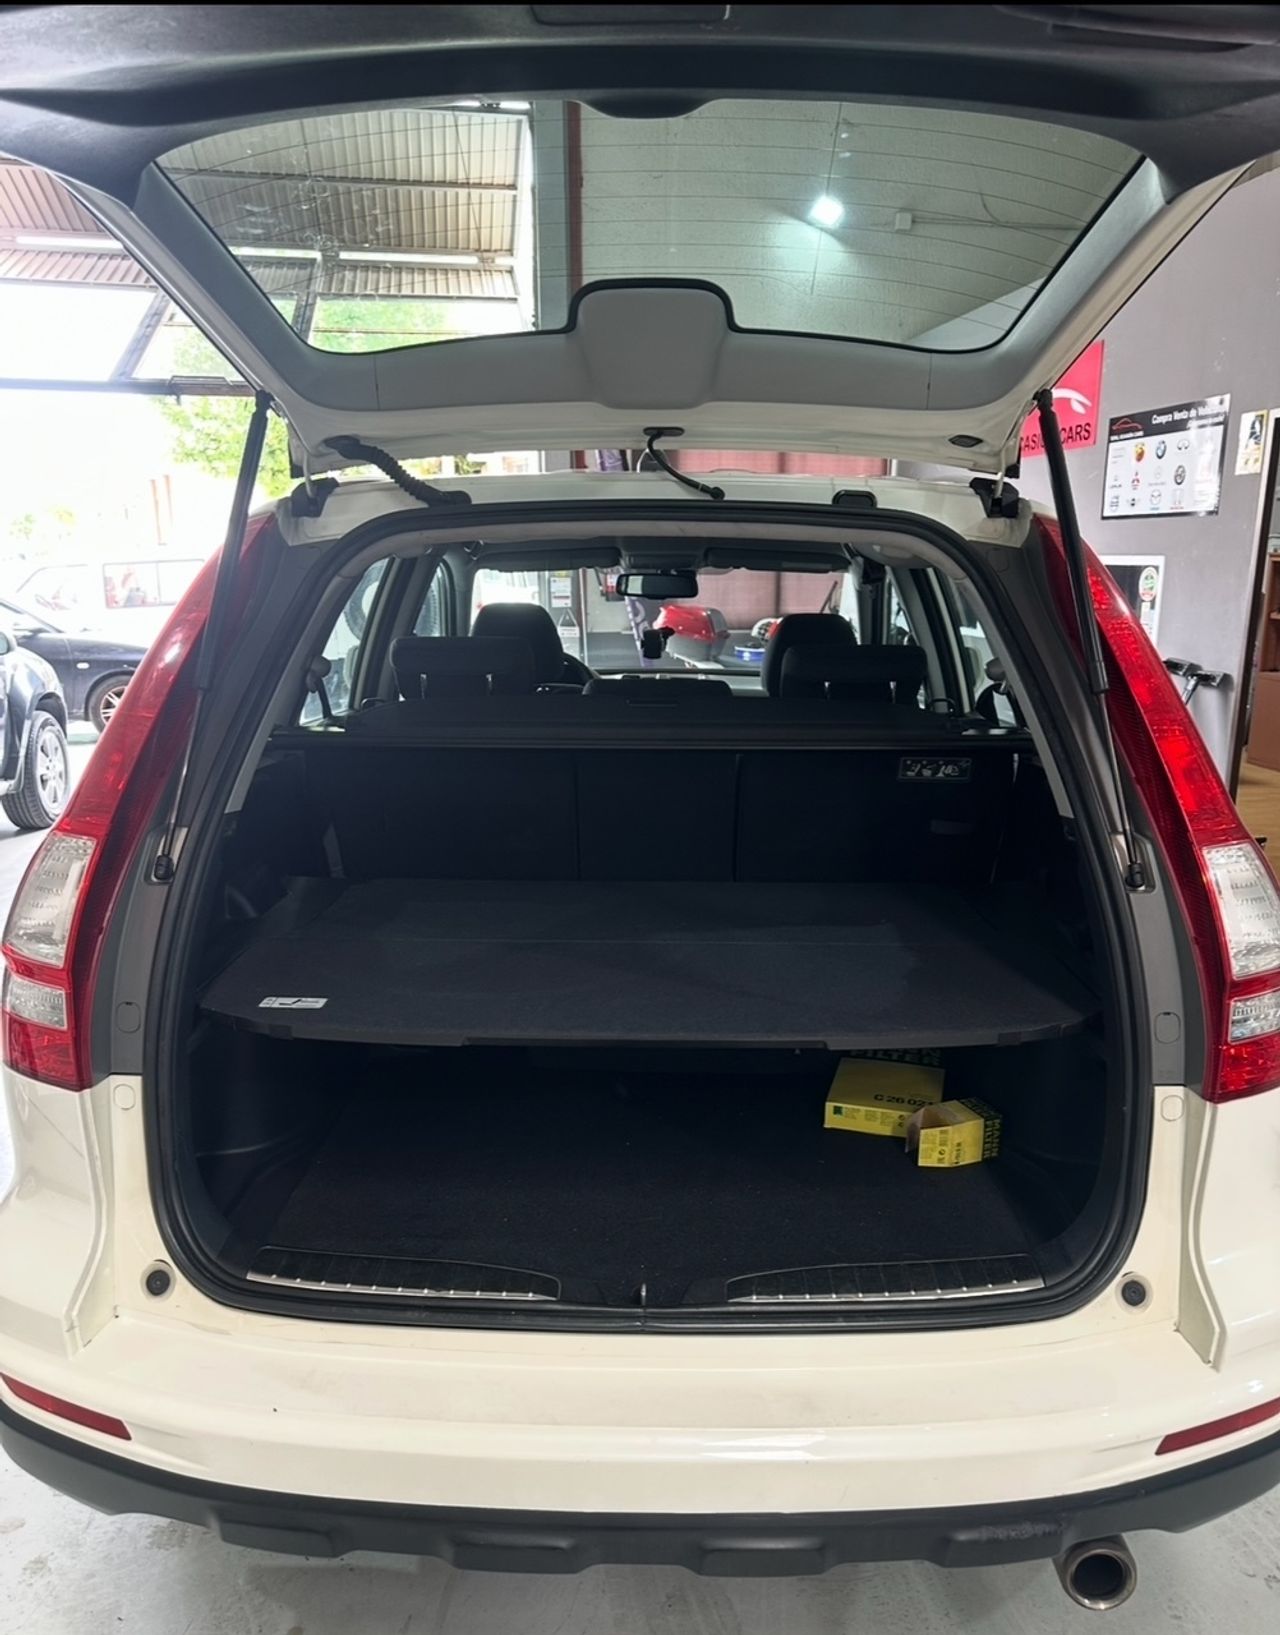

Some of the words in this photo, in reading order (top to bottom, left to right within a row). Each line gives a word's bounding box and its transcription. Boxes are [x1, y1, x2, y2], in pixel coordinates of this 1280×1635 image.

[1060, 422, 1092, 445] CARS
[983, 1120, 993, 1159] FILTER
[991, 1118, 1001, 1157] MANN
